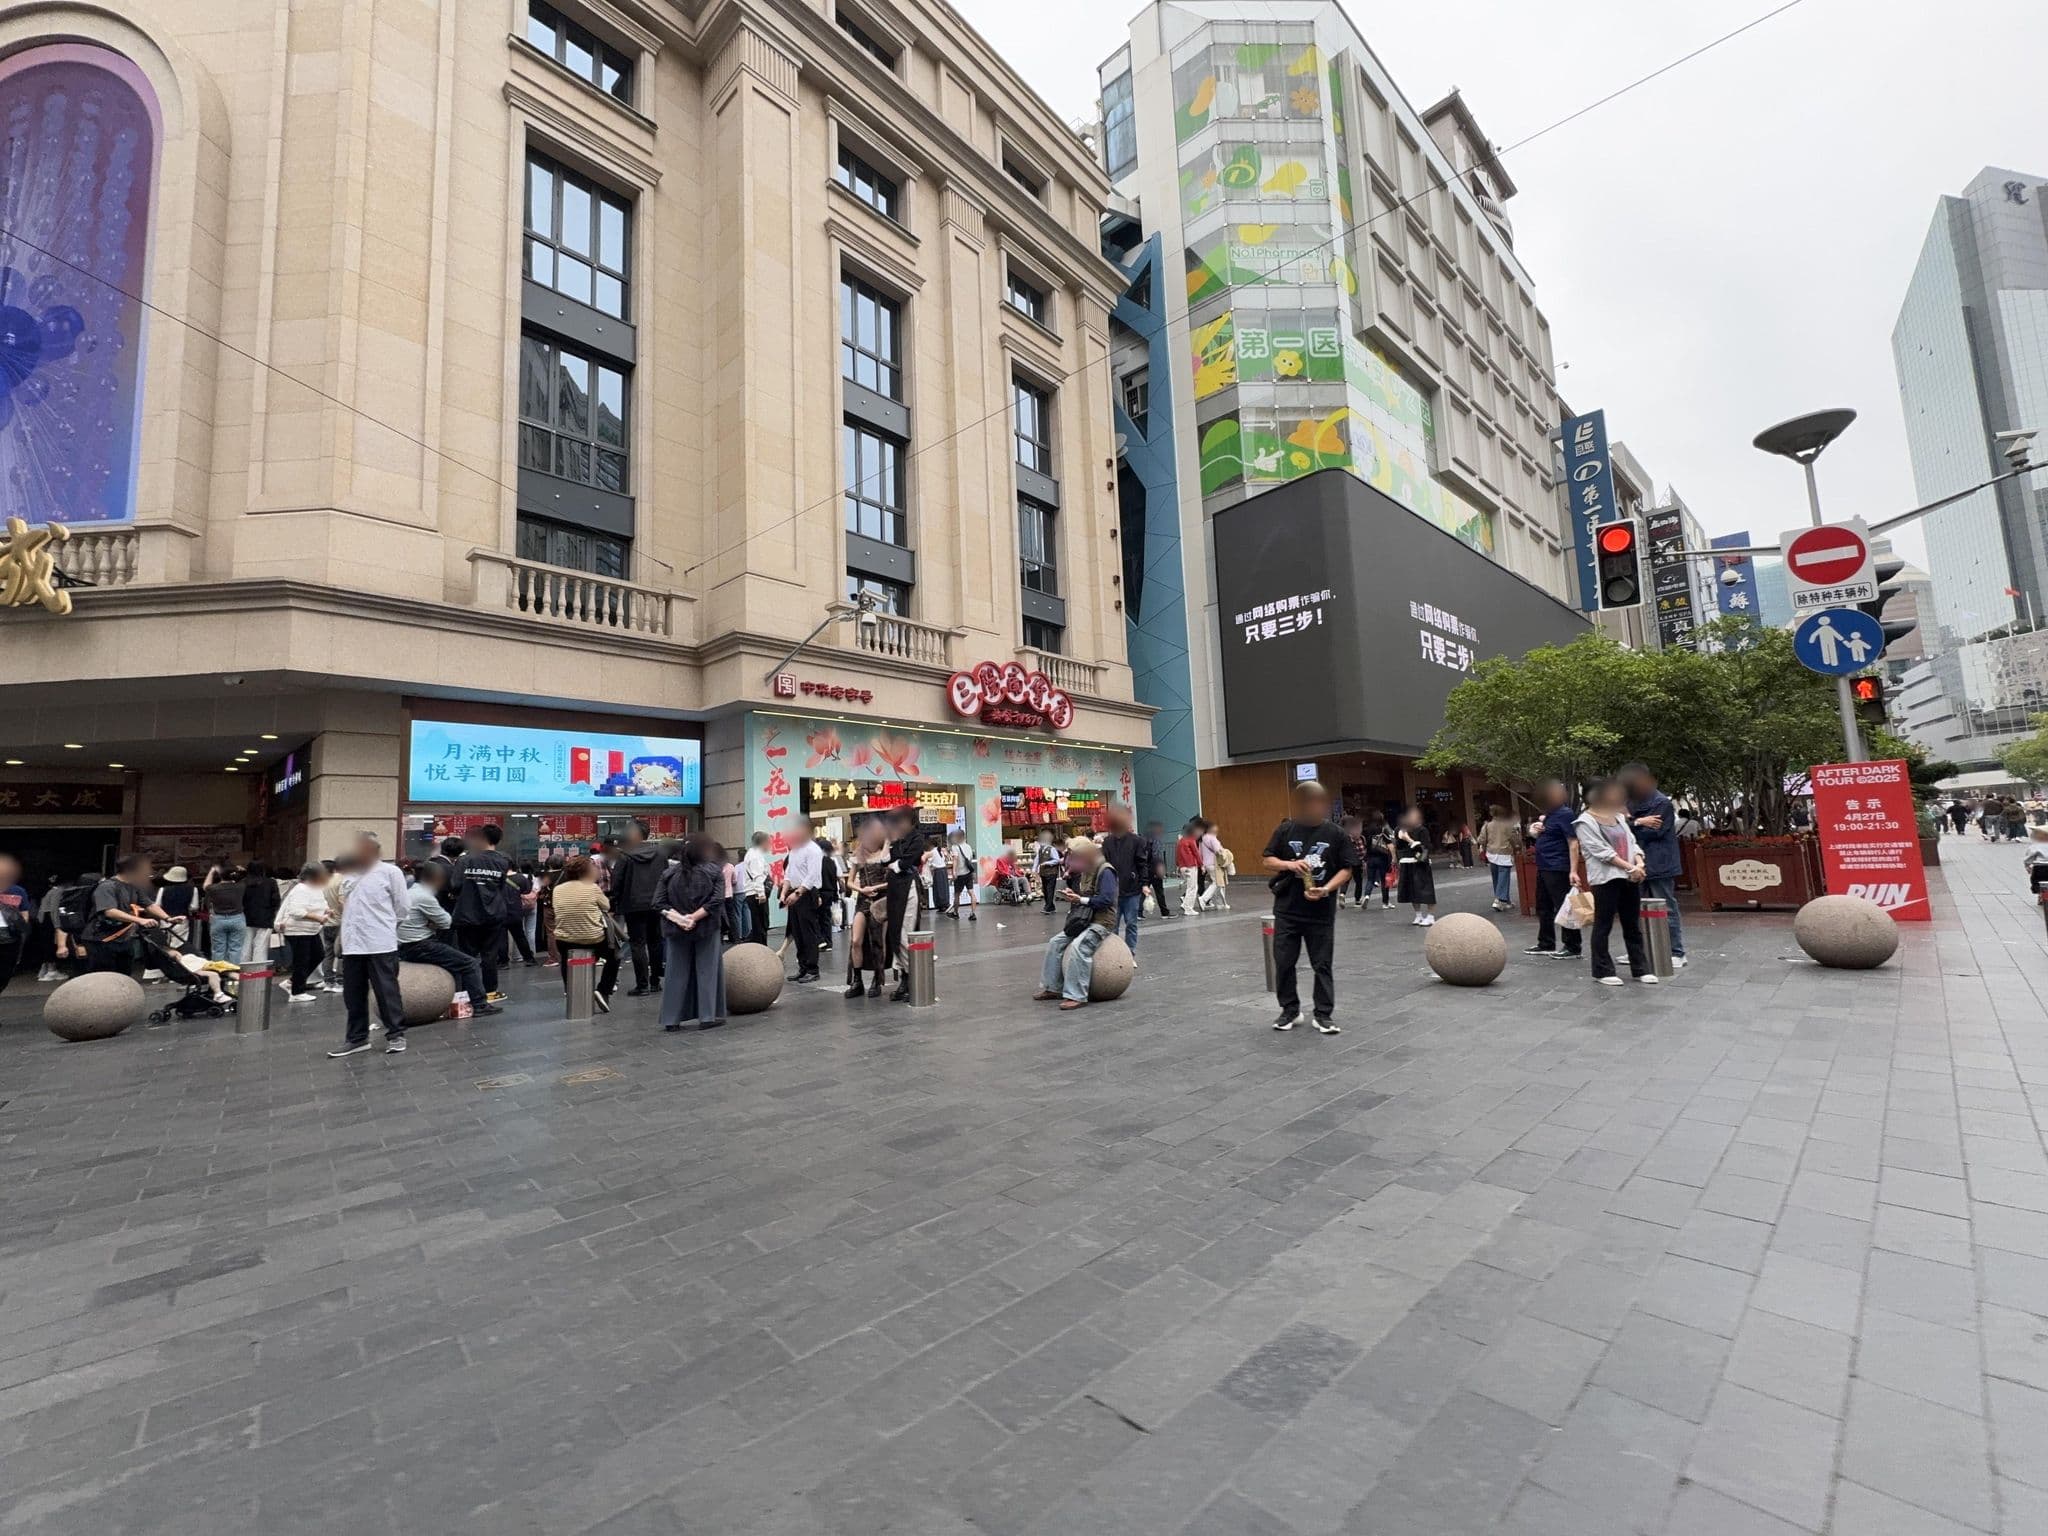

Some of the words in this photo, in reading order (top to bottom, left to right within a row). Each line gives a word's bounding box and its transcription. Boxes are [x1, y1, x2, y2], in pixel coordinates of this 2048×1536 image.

[1238, 327, 1341, 358] 第一医
[1797, 586, 1868, 605] 除特种车辆外
[800, 681, 874, 704] 中华老字号
[442, 743, 543, 763] 月满中秋
[424, 763, 526, 783] 悦享团圆
[1816, 768, 1860, 778] AFTER
[1862, 764, 1901, 775] DARK
[1816, 776, 1854, 786] TOUR
[1844, 812, 1886, 821] 4月27日
[1833, 821, 1899, 832] 19:00-21:30
[1847, 883, 1912, 905] RUN
